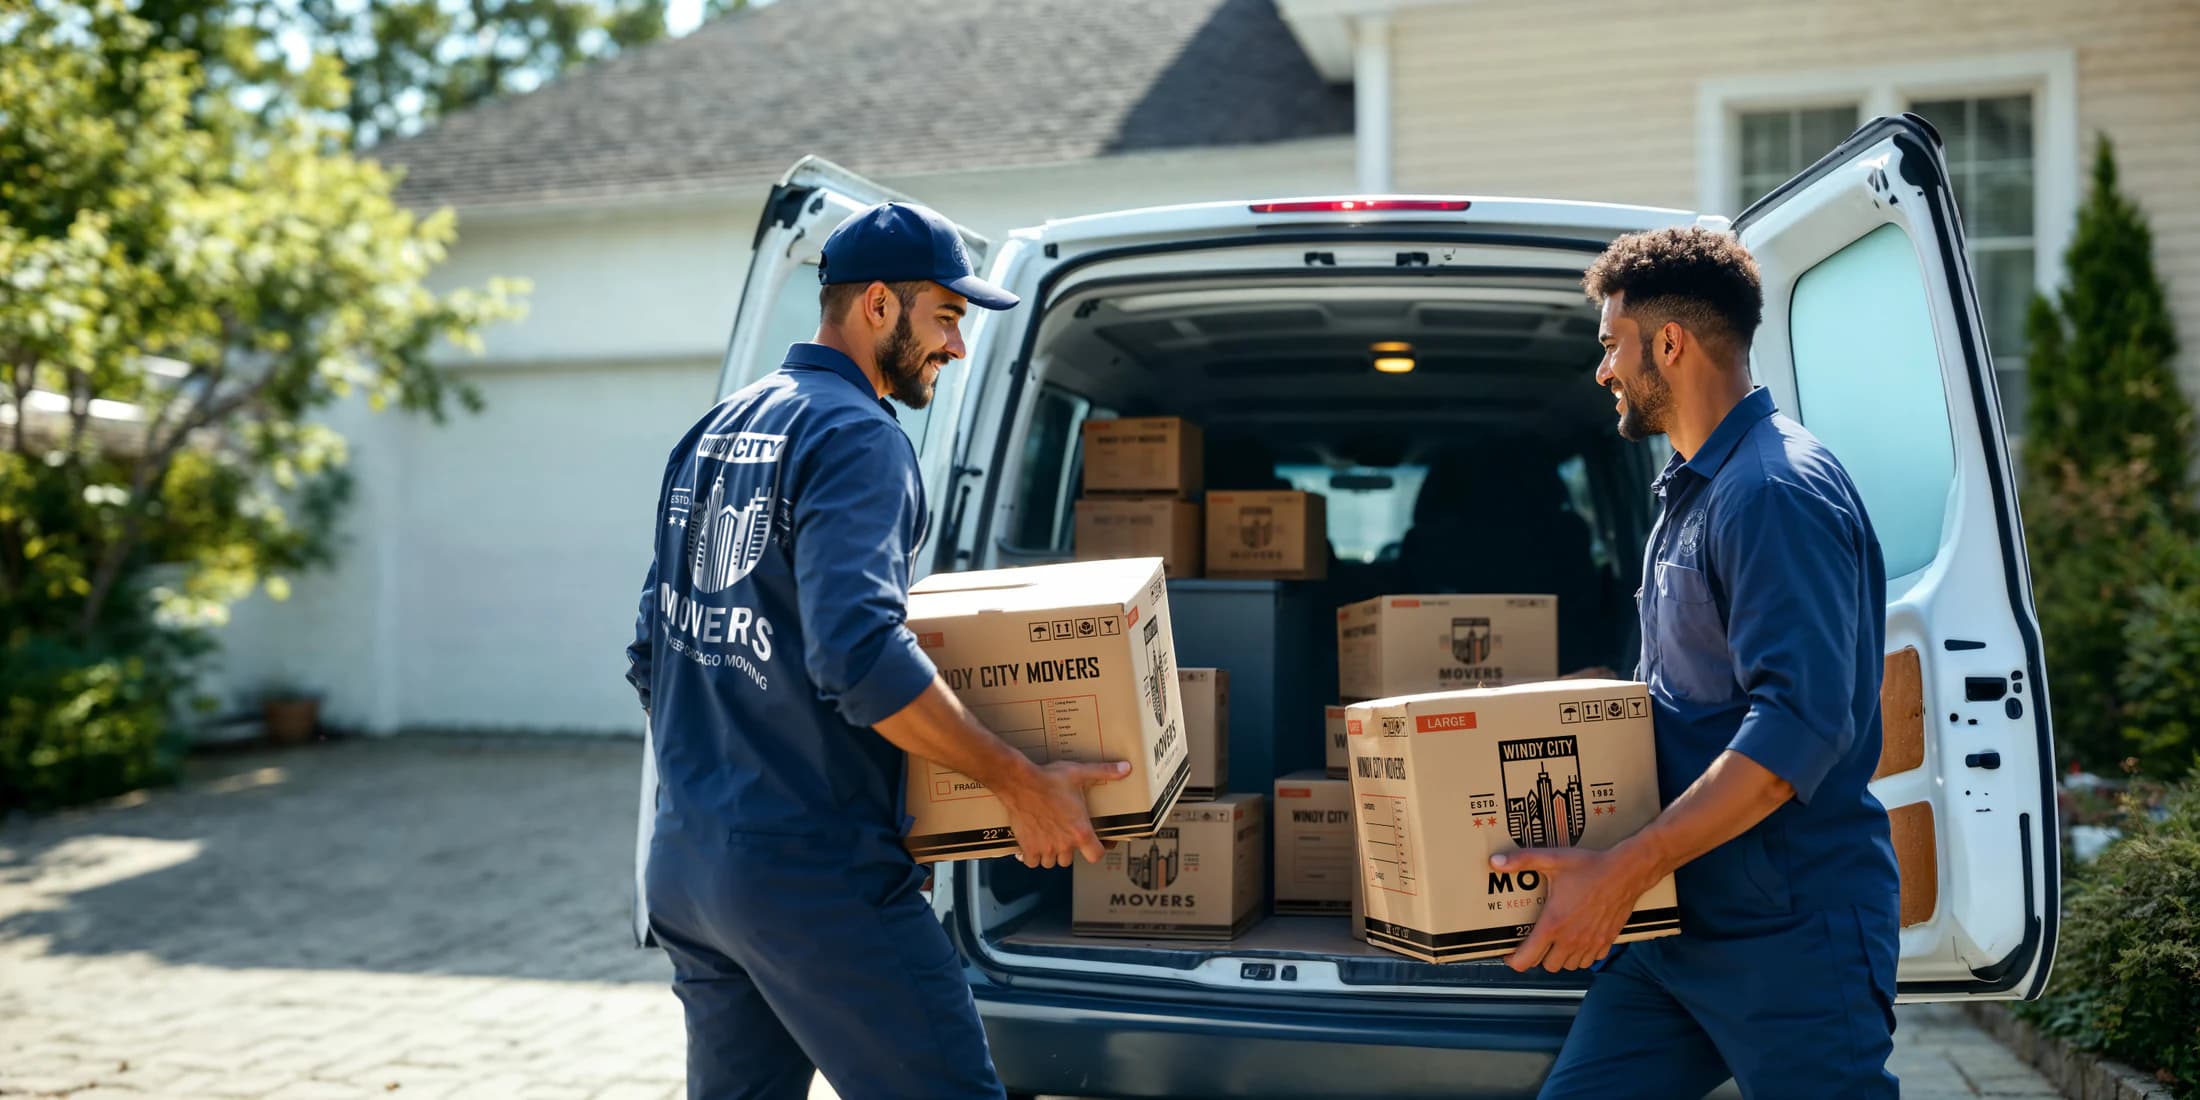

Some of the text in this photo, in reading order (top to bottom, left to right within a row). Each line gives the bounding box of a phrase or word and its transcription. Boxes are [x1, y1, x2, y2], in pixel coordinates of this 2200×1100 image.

[733, 438, 782, 458] CITY
[670, 495, 692, 506] ESTD.
[661, 582, 773, 662] MOVERS
[724, 655, 768, 691] MOVING
[980, 664, 1019, 688] CITY
[1026, 657, 1100, 684] MOVERS
[1439, 667, 1503, 680] MOVERS
[1427, 715, 1466, 729] LARGE
[1154, 719, 1177, 767] MOVERS
[1503, 739, 1573, 760] WINDY CITY
[1591, 788, 1614, 798] 1982
[1471, 799, 1498, 809] ESTD.
[1292, 809, 1349, 823] WINDY CITY
[1110, 893, 1195, 908] MOVERS
[1488, 901, 1503, 911] WE
[1506, 898, 1532, 909] KEEP
